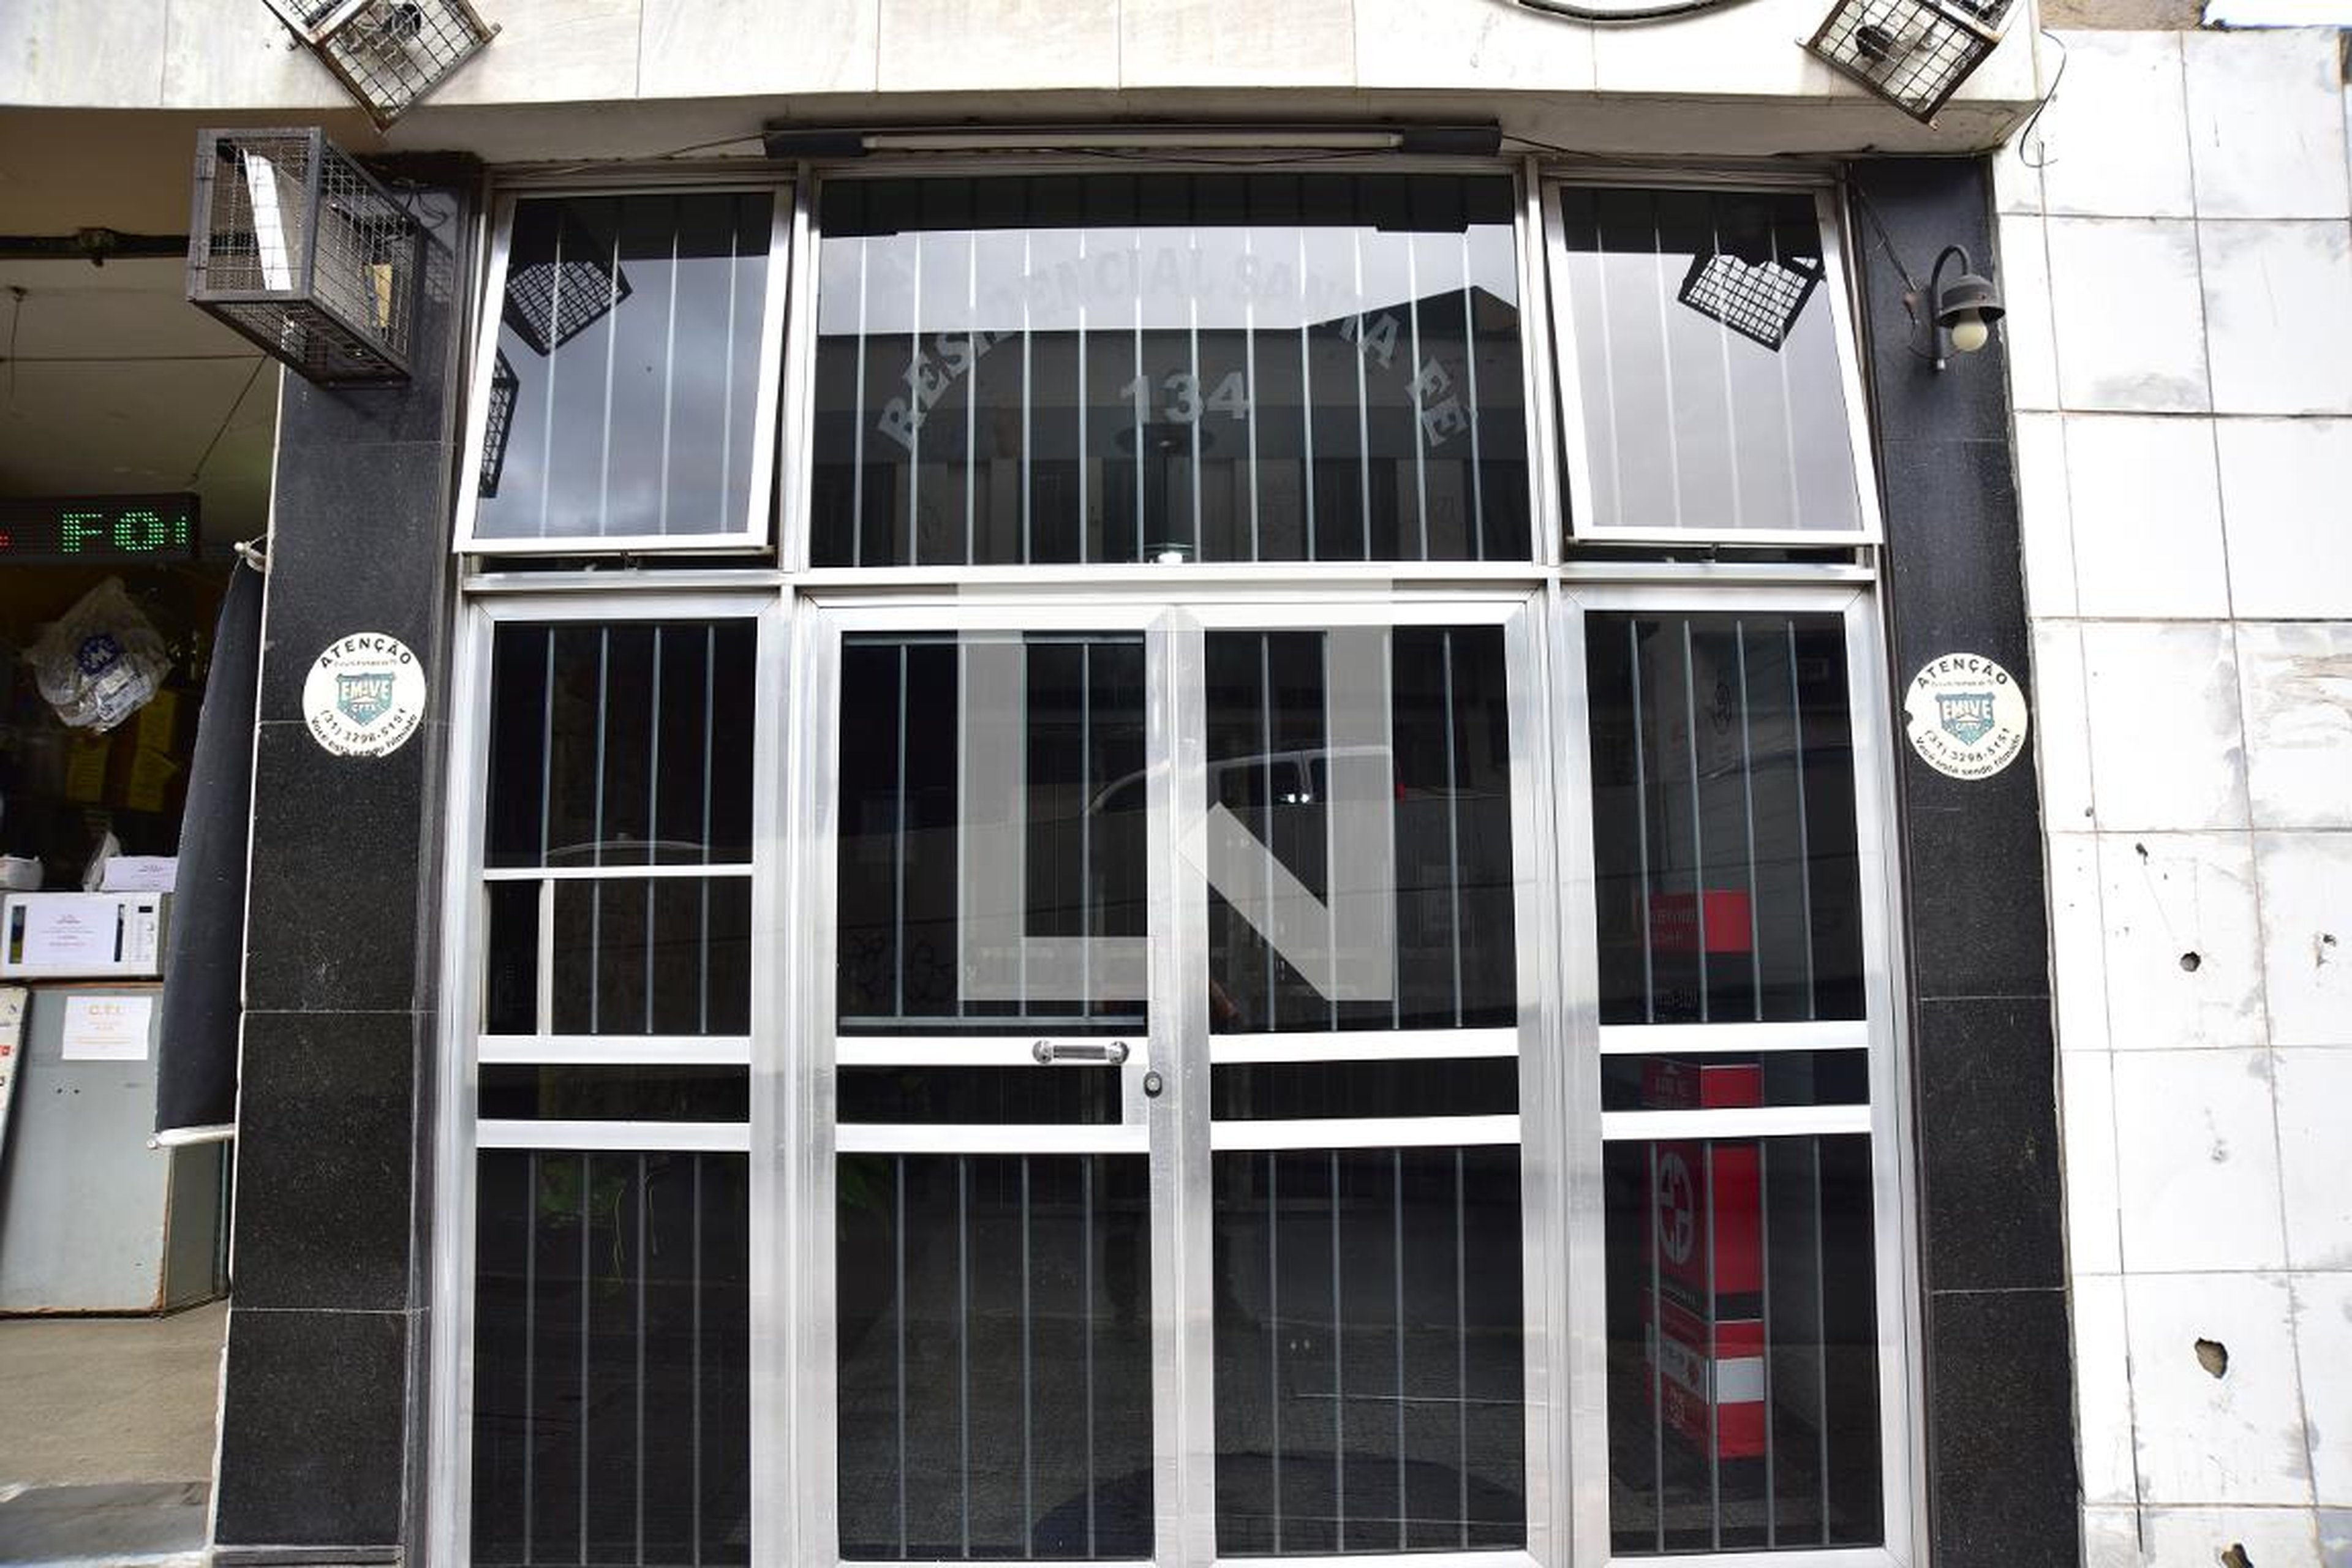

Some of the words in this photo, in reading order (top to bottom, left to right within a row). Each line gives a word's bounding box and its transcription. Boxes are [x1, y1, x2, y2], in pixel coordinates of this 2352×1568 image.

[1120, 370, 1251, 425] 134
[320, 638, 412, 668] ATENÇÃO
[1917, 658, 2008, 690] ATENÇÃO
